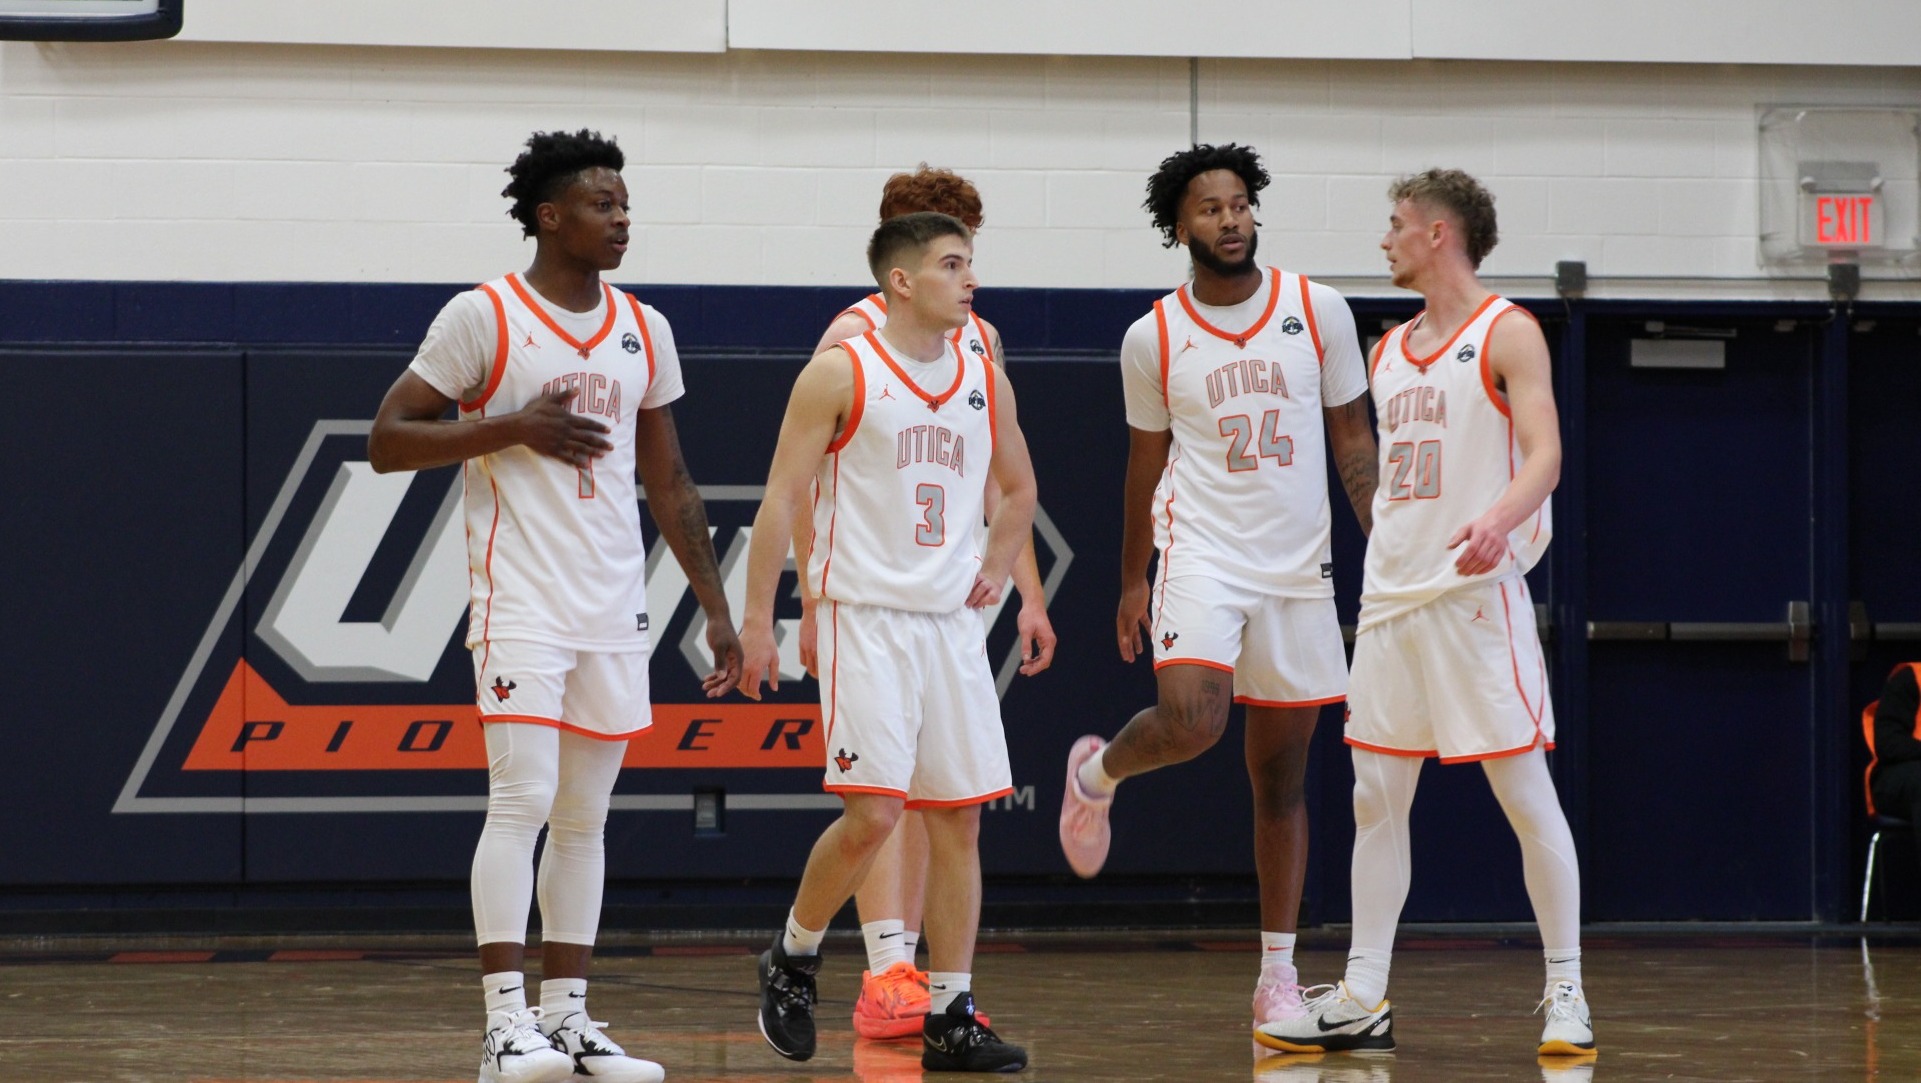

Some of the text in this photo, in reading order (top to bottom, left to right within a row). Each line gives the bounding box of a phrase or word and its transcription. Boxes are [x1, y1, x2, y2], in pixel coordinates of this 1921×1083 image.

[1816, 197, 1873, 243] EXIT
[1205, 359, 1289, 409] UTICA
[1387, 386, 1447, 433] UTICA
[897, 425, 964, 478] UTICA
[1218, 409, 1294, 472] 24
[1388, 439, 1441, 501] 20
[915, 483, 945, 546] 3
[230, 720, 815, 752] PIOER
